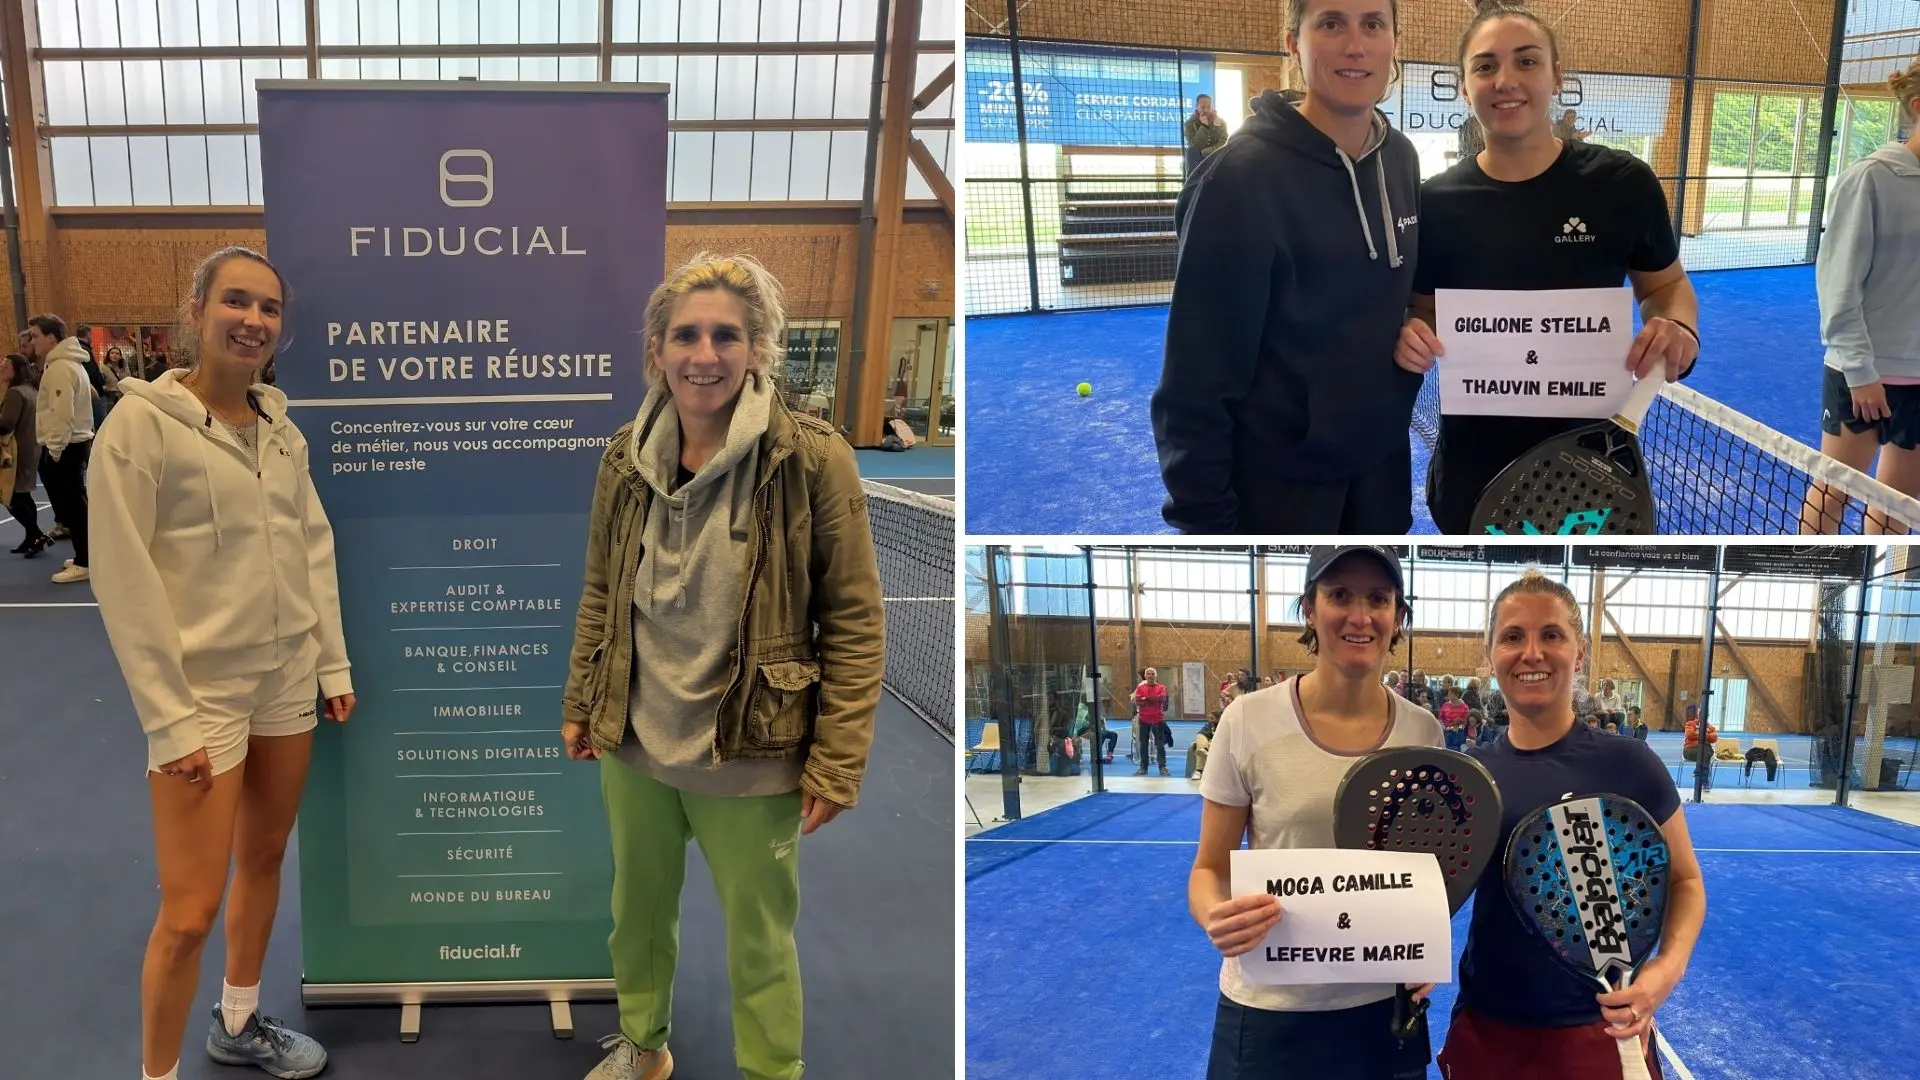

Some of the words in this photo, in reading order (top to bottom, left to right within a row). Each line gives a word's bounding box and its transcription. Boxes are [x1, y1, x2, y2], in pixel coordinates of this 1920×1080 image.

[1075, 93, 1129, 106] SERVICE
[980, 102, 1049, 115] MINIUM
[1076, 109, 1112, 120] CLUB
[350, 225, 587, 257] FIDUCIAL
[1554, 234, 1596, 243] GALLERY
[327, 319, 509, 346] PARTENAIRE
[1455, 317, 1532, 333] GIGLIONE
[1540, 317, 1611, 333] STELLA
[329, 358, 365, 382] DE
[378, 356, 473, 381] VOTRE
[487, 348, 612, 379] RÉUSSITE
[1525, 350, 1538, 365] &
[1462, 379, 1540, 395] THAUVIN
[1548, 381, 1606, 396] EMILIE
[330, 420, 461, 435] Concentrez-vous
[465, 421, 486, 431] sur
[491, 419, 528, 431] votre
[533, 418, 574, 430] cœur
[331, 441, 351, 454] de
[356, 439, 409, 454] métier,
[413, 440, 449, 452] nous
[453, 439, 488, 451] vous
[492, 435, 611, 453] accompagnons
[332, 460, 367, 475] pour
[372, 459, 386, 472] le
[389, 458, 426, 471] reste
[452, 538, 497, 550] DROIT
[1420, 549, 1475, 559] BOUCHERIE
[1601, 550, 1640, 558] confiance
[1682, 552, 1700, 560] bien
[446, 584, 490, 596] AUDIT
[496, 584, 505, 595] &
[390, 600, 465, 613] EXPERTISE
[471, 598, 561, 612] COMPTABLE
[437, 662, 446, 673] &
[452, 660, 517, 673] CONSEIL
[433, 705, 522, 717] IMMOBILIER
[397, 749, 478, 761] SOLUTIONS
[485, 747, 560, 759] DIGITALES
[423, 790, 535, 803] INFORMATIQUE
[415, 807, 423, 818] &
[430, 805, 544, 818] TECHNOLOGIES
[447, 845, 513, 860] SÉCURITÉ
[1266, 876, 1324, 897] MOGA
[1332, 872, 1413, 892] CAMILLE
[410, 890, 465, 903] MONDE
[471, 890, 490, 902] DU
[496, 889, 551, 901] BUREAU
[1337, 912, 1351, 930] &
[439, 944, 521, 960] fiducial.fr
[1266, 946, 1355, 962] LEFEVRE
[1362, 943, 1424, 962] MARIE
